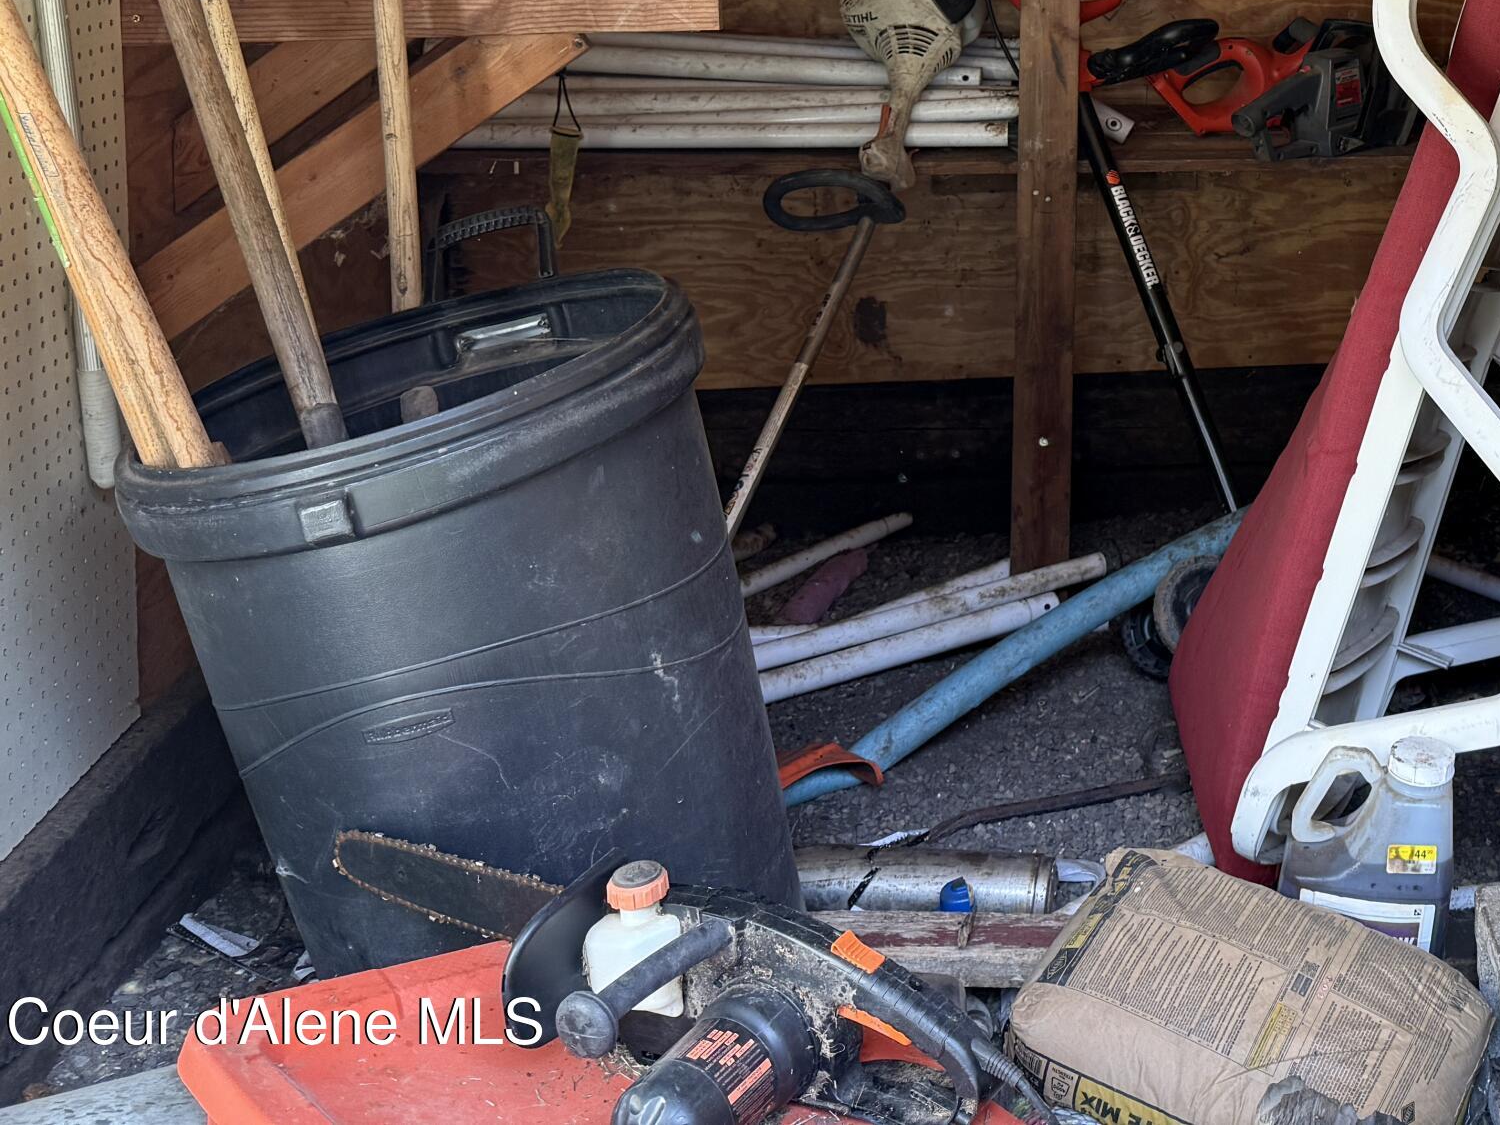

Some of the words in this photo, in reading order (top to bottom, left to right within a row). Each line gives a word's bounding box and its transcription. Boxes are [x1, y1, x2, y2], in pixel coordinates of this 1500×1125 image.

[844, 11, 878, 24] STIHL
[1111, 184, 1160, 288] BLACK&DECKER
[1079, 1091, 1122, 1124] MIX
